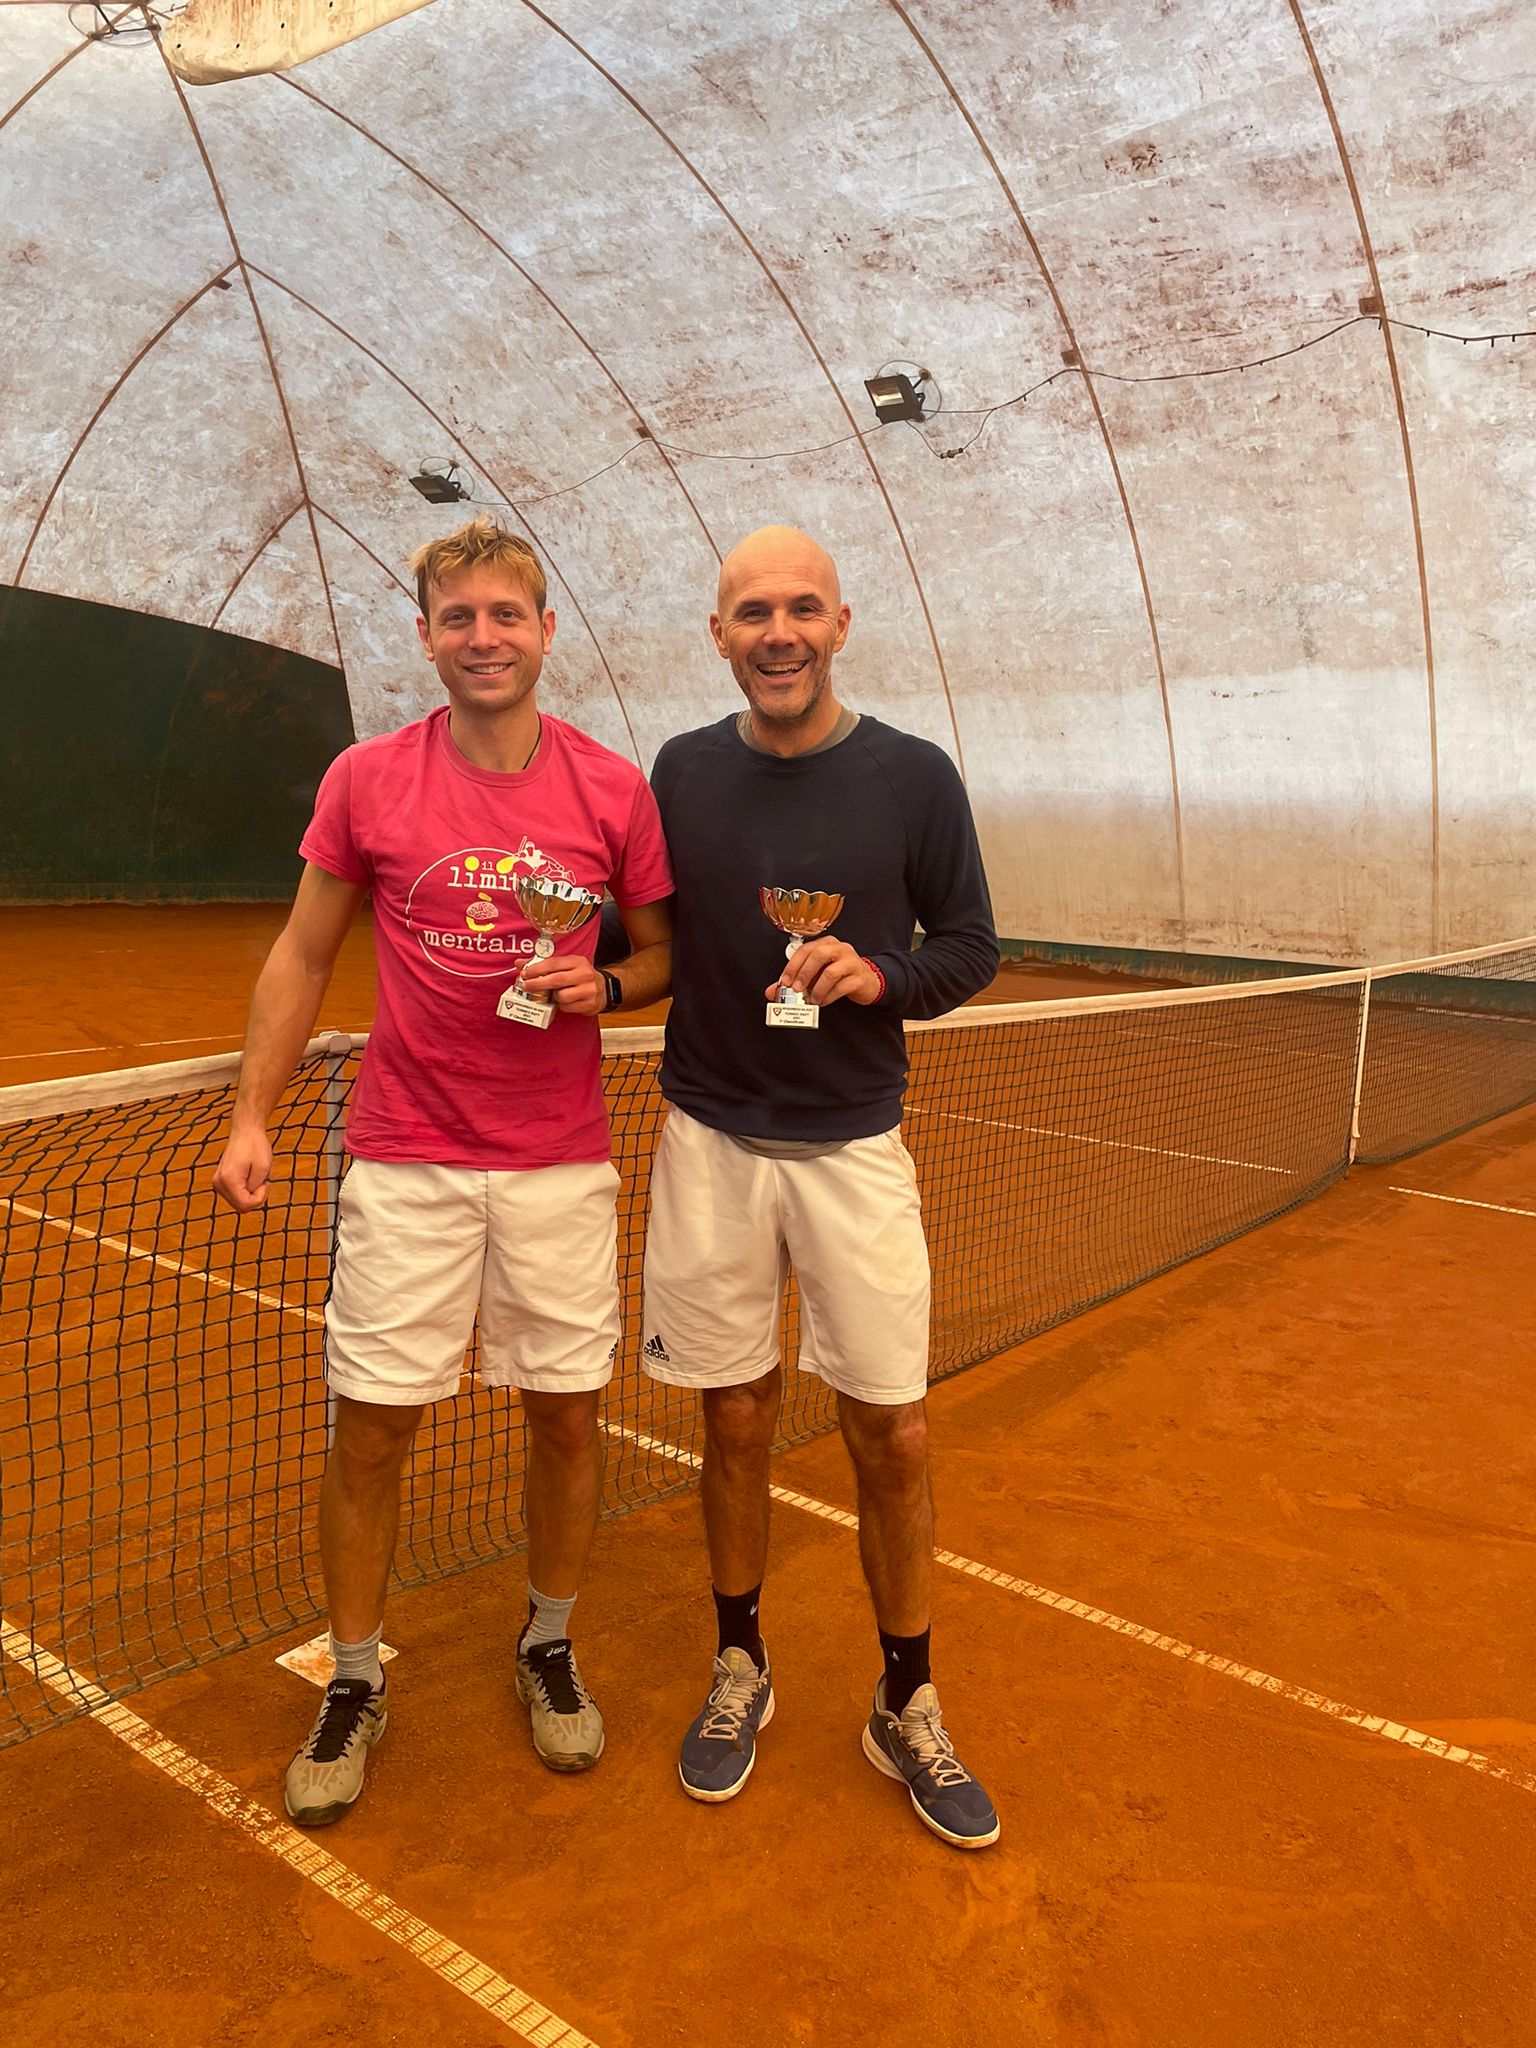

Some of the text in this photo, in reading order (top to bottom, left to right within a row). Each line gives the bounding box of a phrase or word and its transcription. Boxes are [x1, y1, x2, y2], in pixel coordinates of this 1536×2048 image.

[482, 861, 493, 871] il
[447, 866, 518, 892] limit
[423, 930, 534, 954] mentale
[643, 1346, 671, 1362] adidas
